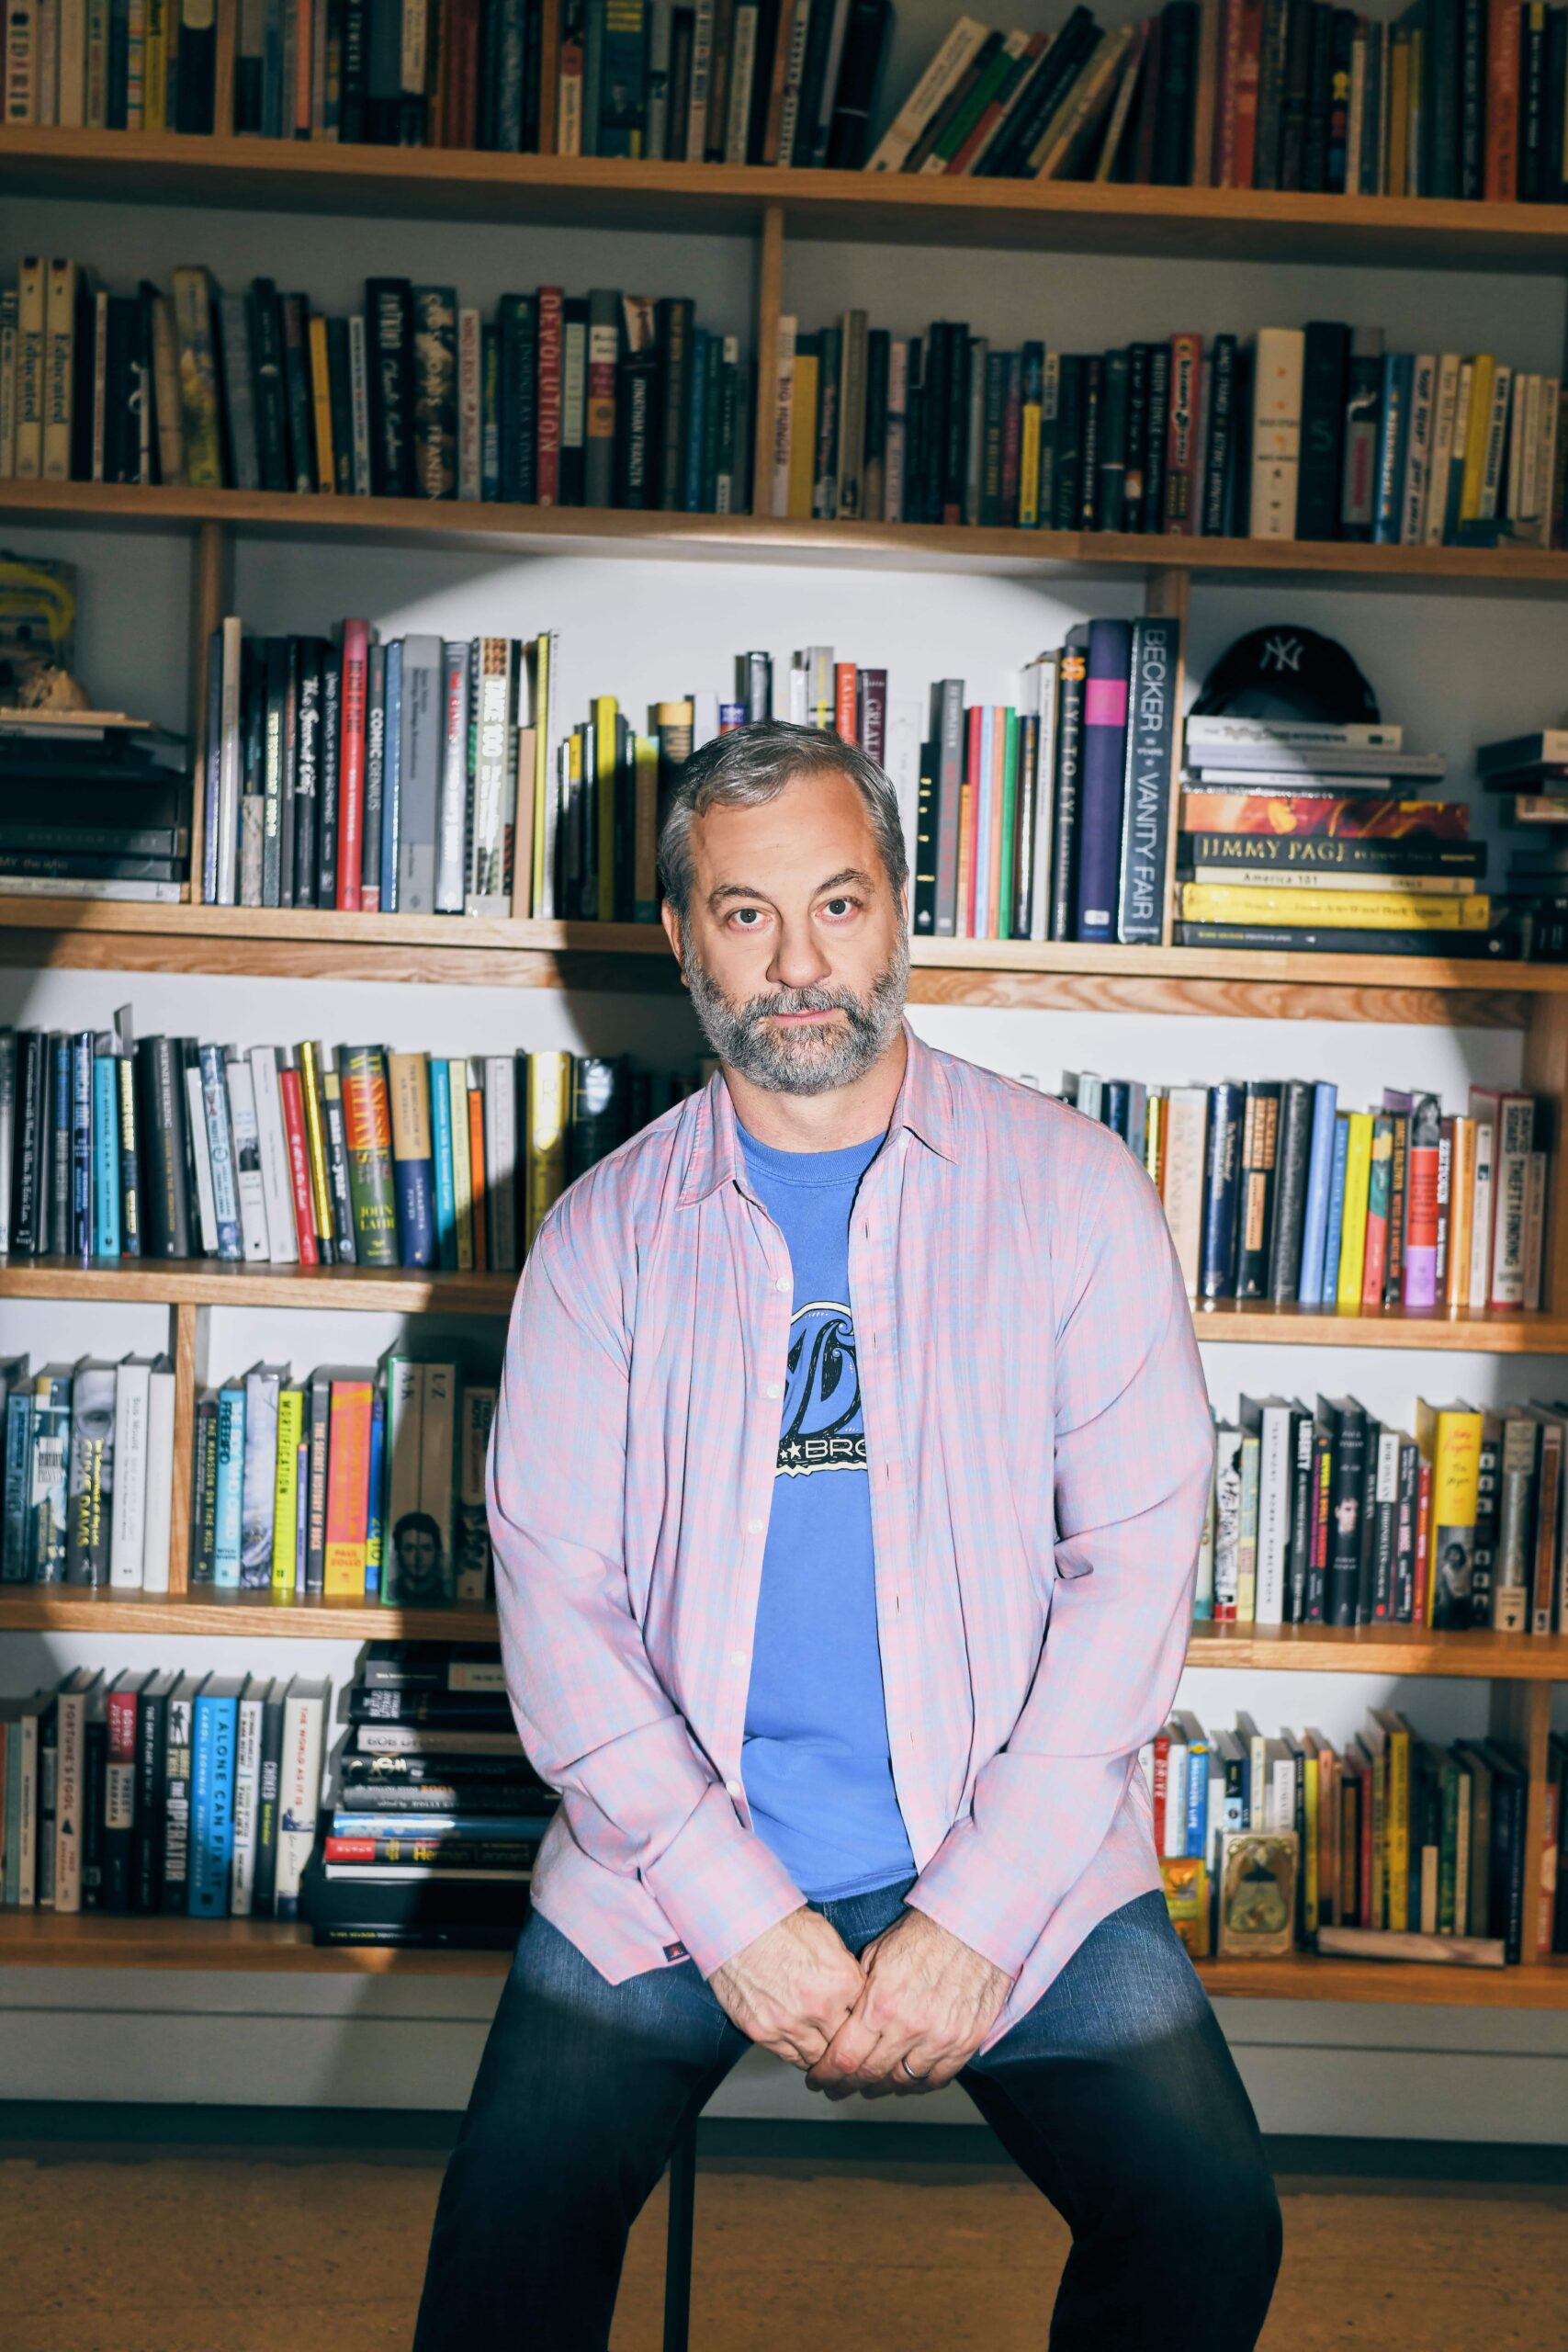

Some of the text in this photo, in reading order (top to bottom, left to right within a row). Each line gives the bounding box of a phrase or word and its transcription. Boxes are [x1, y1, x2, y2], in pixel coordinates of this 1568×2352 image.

[24, 332, 41, 423] Educated
[53, 333, 72, 425] Educated
[538, 294, 559, 454] DEVOLUTION
[777, 377, 792, 402] BIG
[518, 344, 534, 488] DOUGLAS ADAMS
[628, 378, 647, 487] JONATHAN FRANZEN
[425, 424, 443, 500] FRANZEN
[484, 680, 507, 722] TAKE
[299, 708, 320, 763] Second
[367, 707, 383, 811] COMIC GENIUS
[480, 724, 503, 757] 100
[1059, 695, 1081, 827] EYE TO EYE
[295, 763, 316, 797] City
[1131, 628, 1167, 919] BECKER VANITY FAIR
[1201, 836, 1281, 859] JIMMY
[1288, 841, 1347, 862] PAGE
[1243, 873, 1318, 886] America 101
[159, 1042, 172, 1086] WERNER
[20, 1042, 37, 1224] Conversations with Woody Allen. By Eric Lax.
[349, 1053, 370, 1166] WILLIAMS
[329, 1109, 346, 1200] man year
[440, 1128, 450, 1146] with
[56, 1130, 69, 1202] DAVID WESTIN
[407, 1189, 416, 1220] POWER
[415, 1177, 425, 1230] SAMANTHA
[1505, 1158, 1525, 1267] THEFT FINDING
[229, 1400, 243, 1494] THE BOY WHO
[1297, 1419, 1313, 1470] LIBERTY
[75, 1438, 93, 1547] CLIVE DAVIS
[204, 1417, 216, 1553] THE MANSION ON THE HILL
[310, 1421, 325, 1551] THE SECRET HISTORY OF ROCK
[110, 1702, 122, 1752] JUSTICE
[122, 1708, 133, 1747] DOING
[146, 1705, 155, 1720] THE
[199, 1706, 209, 1743] CAROL
[63, 1702, 75, 1811] FORTUNE'S FOOL
[197, 1747, 208, 1796] LEONNIG
[215, 1722, 229, 1781] ALONE
[295, 1706, 309, 1806] THE WORLD AS IT IS
[109, 1769, 120, 1822] BHARARA
[121, 1777, 132, 1815] PREET
[262, 1761, 277, 1800] CHOKED
[1154, 1758, 1167, 1799] DRIVE
[165, 1781, 187, 1882] THE OPERATOR
[197, 1804, 206, 1840] PHILIP
[213, 1789, 227, 1826] CAN
[1188, 1809, 1199, 1828] LIFE
[212, 1835, 226, 1866] FIX
[412, 1845, 468, 1861] Herman
[211, 1871, 224, 1889] IT
